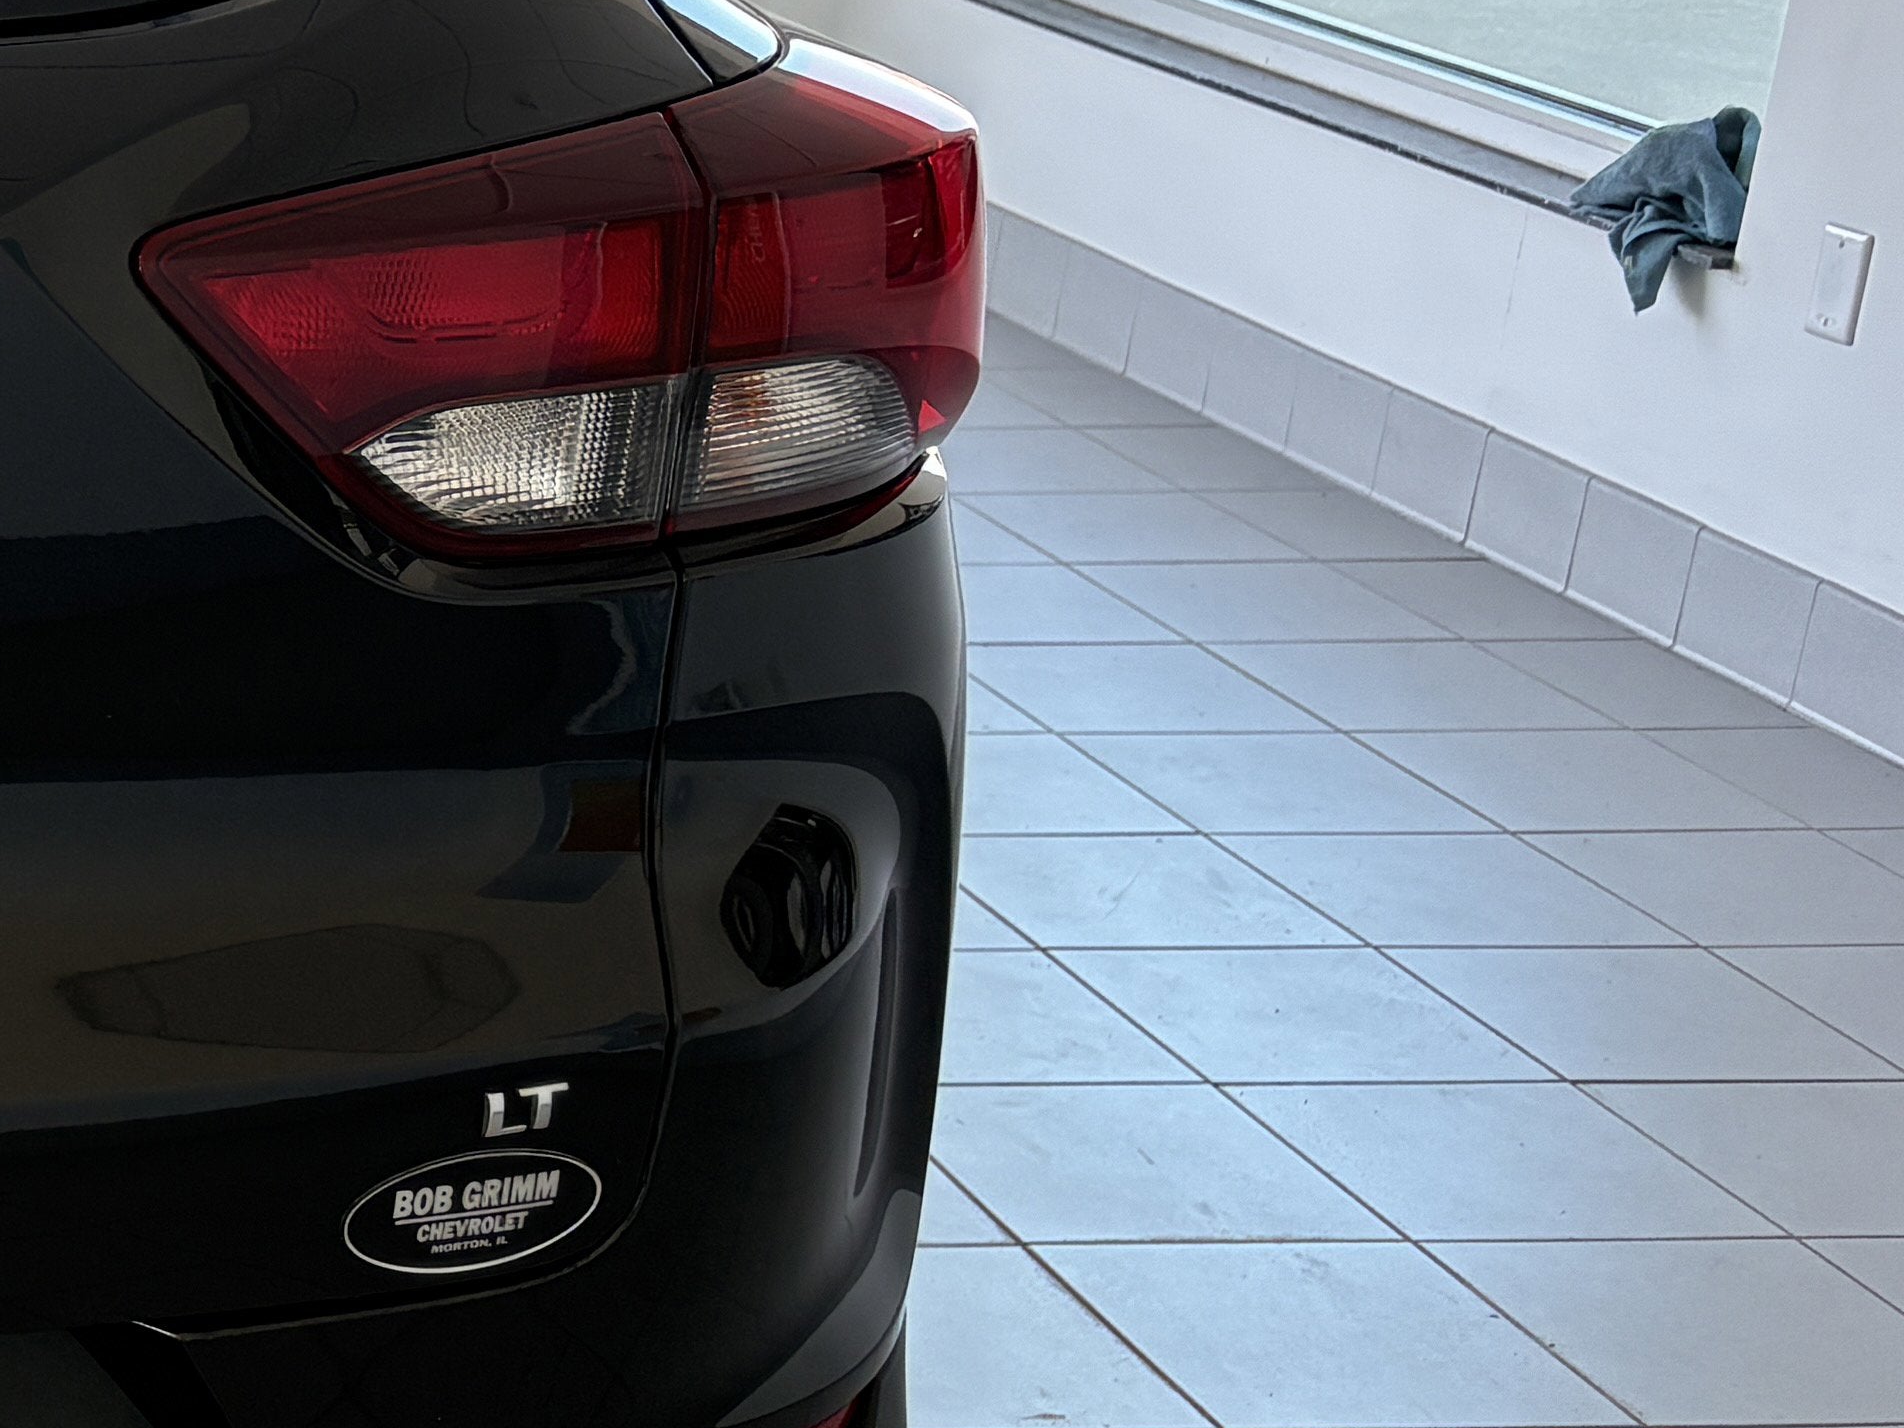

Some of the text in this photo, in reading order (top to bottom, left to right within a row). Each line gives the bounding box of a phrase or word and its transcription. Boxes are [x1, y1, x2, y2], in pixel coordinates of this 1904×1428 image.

[485, 1082, 569, 1138] LT
[392, 1169, 561, 1219] BOB GRIMM
[416, 1211, 529, 1243] CHEVROLET
